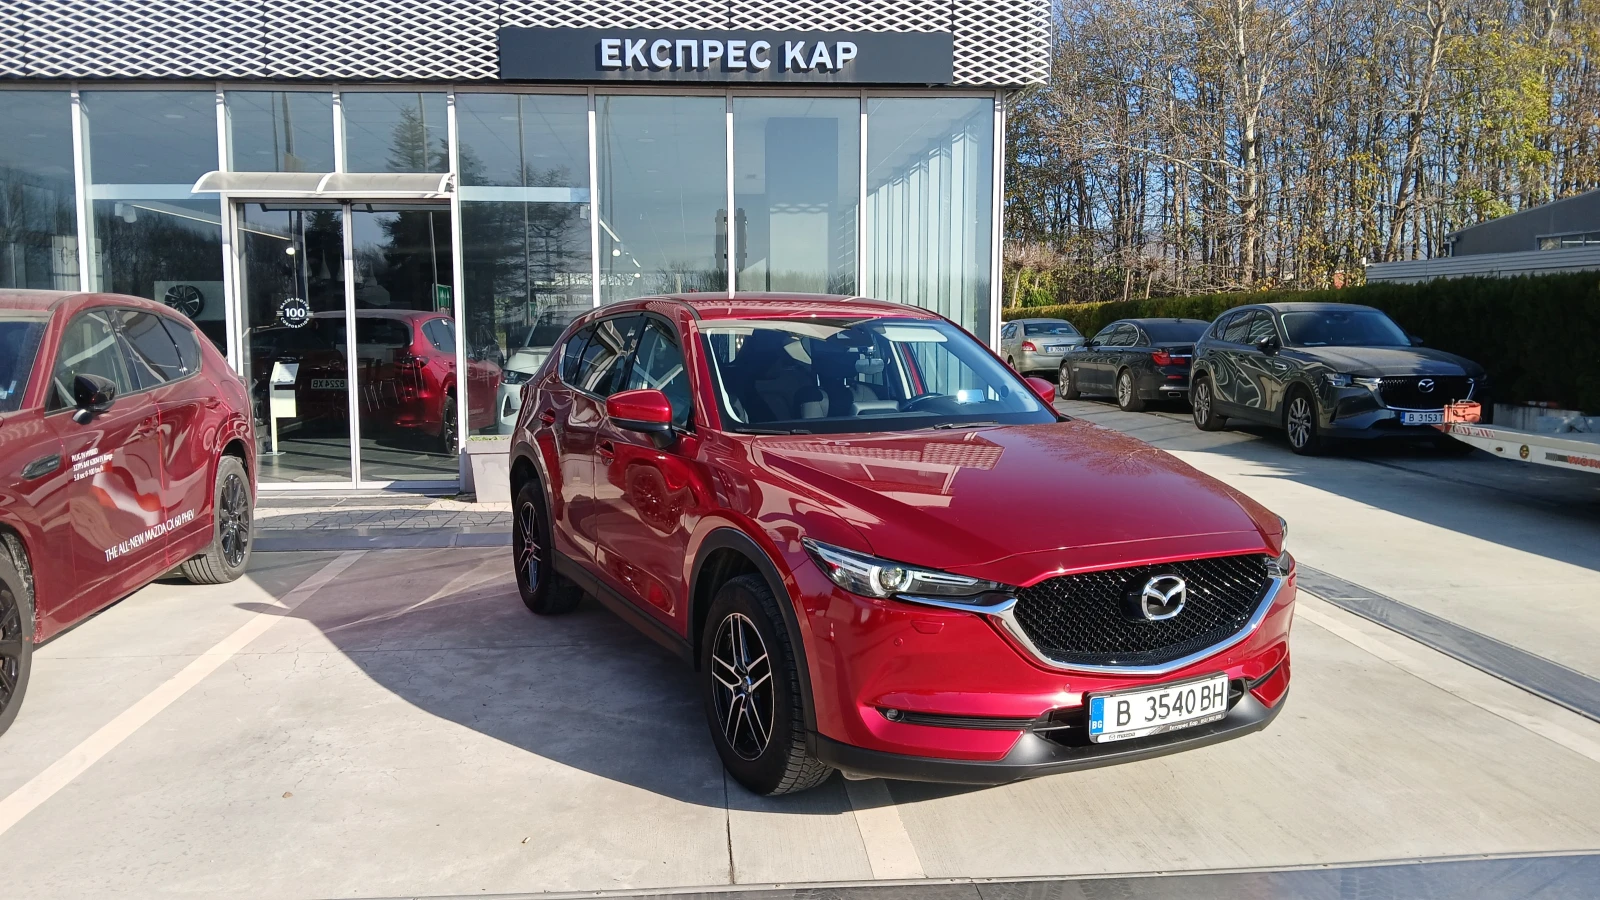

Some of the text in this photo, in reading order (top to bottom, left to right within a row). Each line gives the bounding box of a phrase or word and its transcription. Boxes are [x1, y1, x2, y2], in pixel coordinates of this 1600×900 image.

[601, 38, 858, 69] ЕКСПРЕС КАР
[285, 308, 305, 318] 100
[280, 317, 310, 329] CORPORATION
[1409, 414, 1415, 422] B
[1418, 413, 1438, 422] 3153
[104, 508, 195, 562] THE ALL-NEW MAZDA CX 60 PHEV
[1091, 720, 1103, 730] BG
[1116, 700, 1131, 727] B
[1144, 688, 1196, 723] 3540
[1200, 681, 1225, 712] BH
[1116, 731, 1136, 740] mazda
